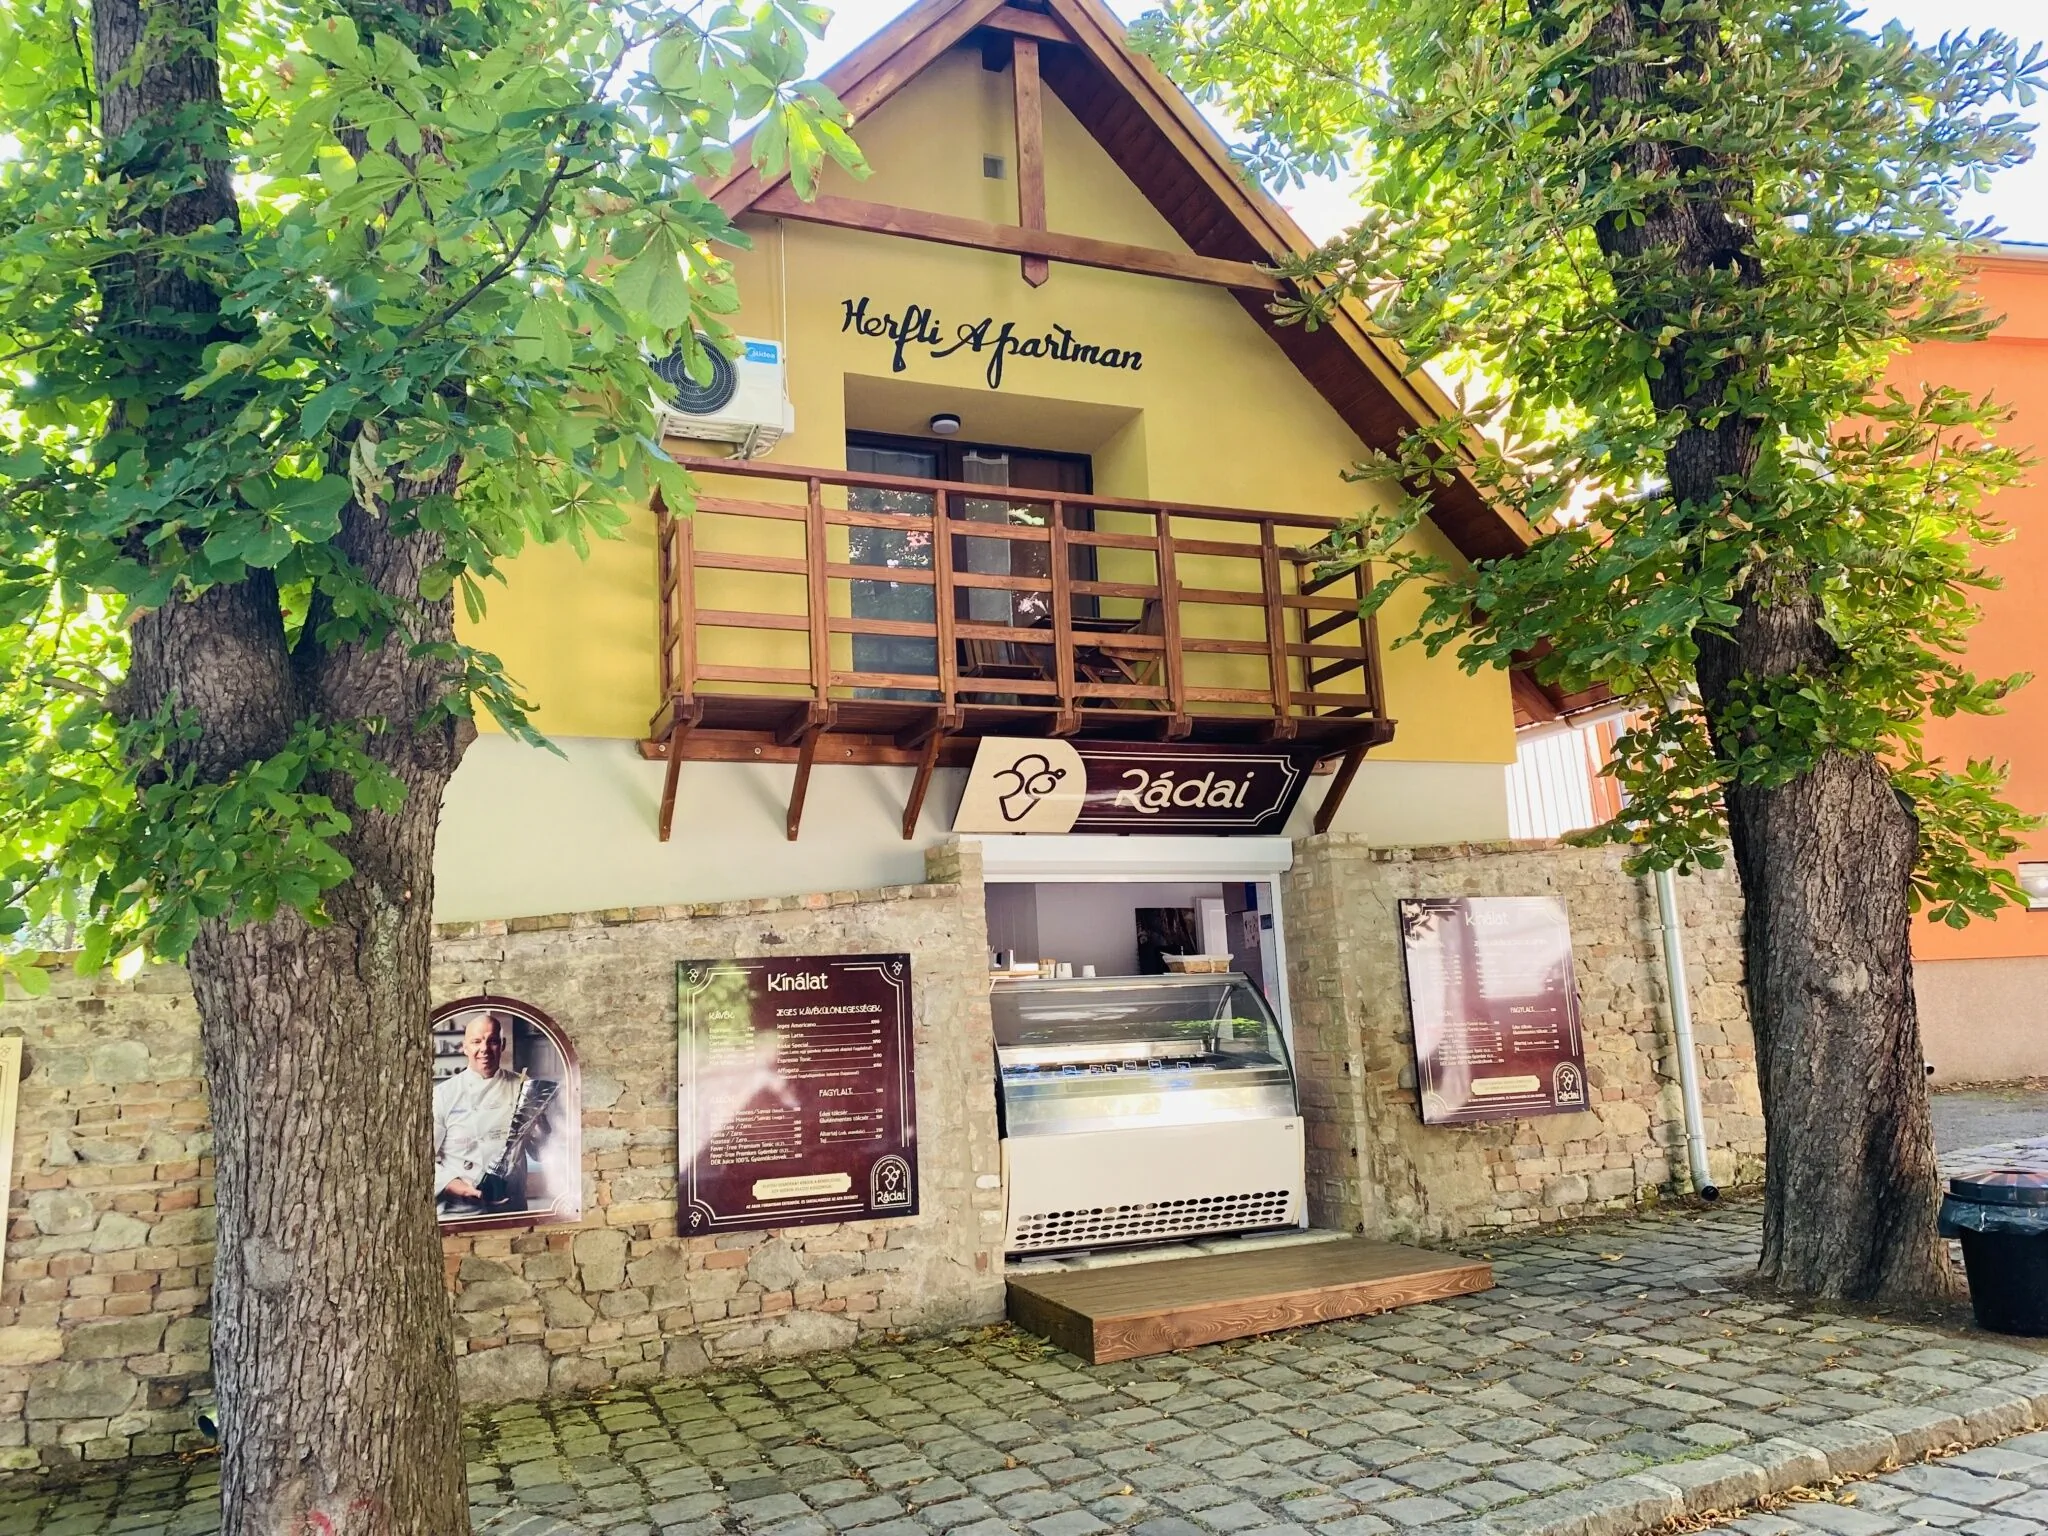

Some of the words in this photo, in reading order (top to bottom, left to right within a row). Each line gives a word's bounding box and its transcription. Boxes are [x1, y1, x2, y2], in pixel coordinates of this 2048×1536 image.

[841, 297, 944, 372] Herfli
[930, 318, 1142, 389] Apartman
[1114, 768, 1255, 814] Rádai
[767, 972, 829, 992] Kínálat
[819, 1087, 853, 1097] FAGYLALT
[876, 1189, 906, 1204] Rádai
